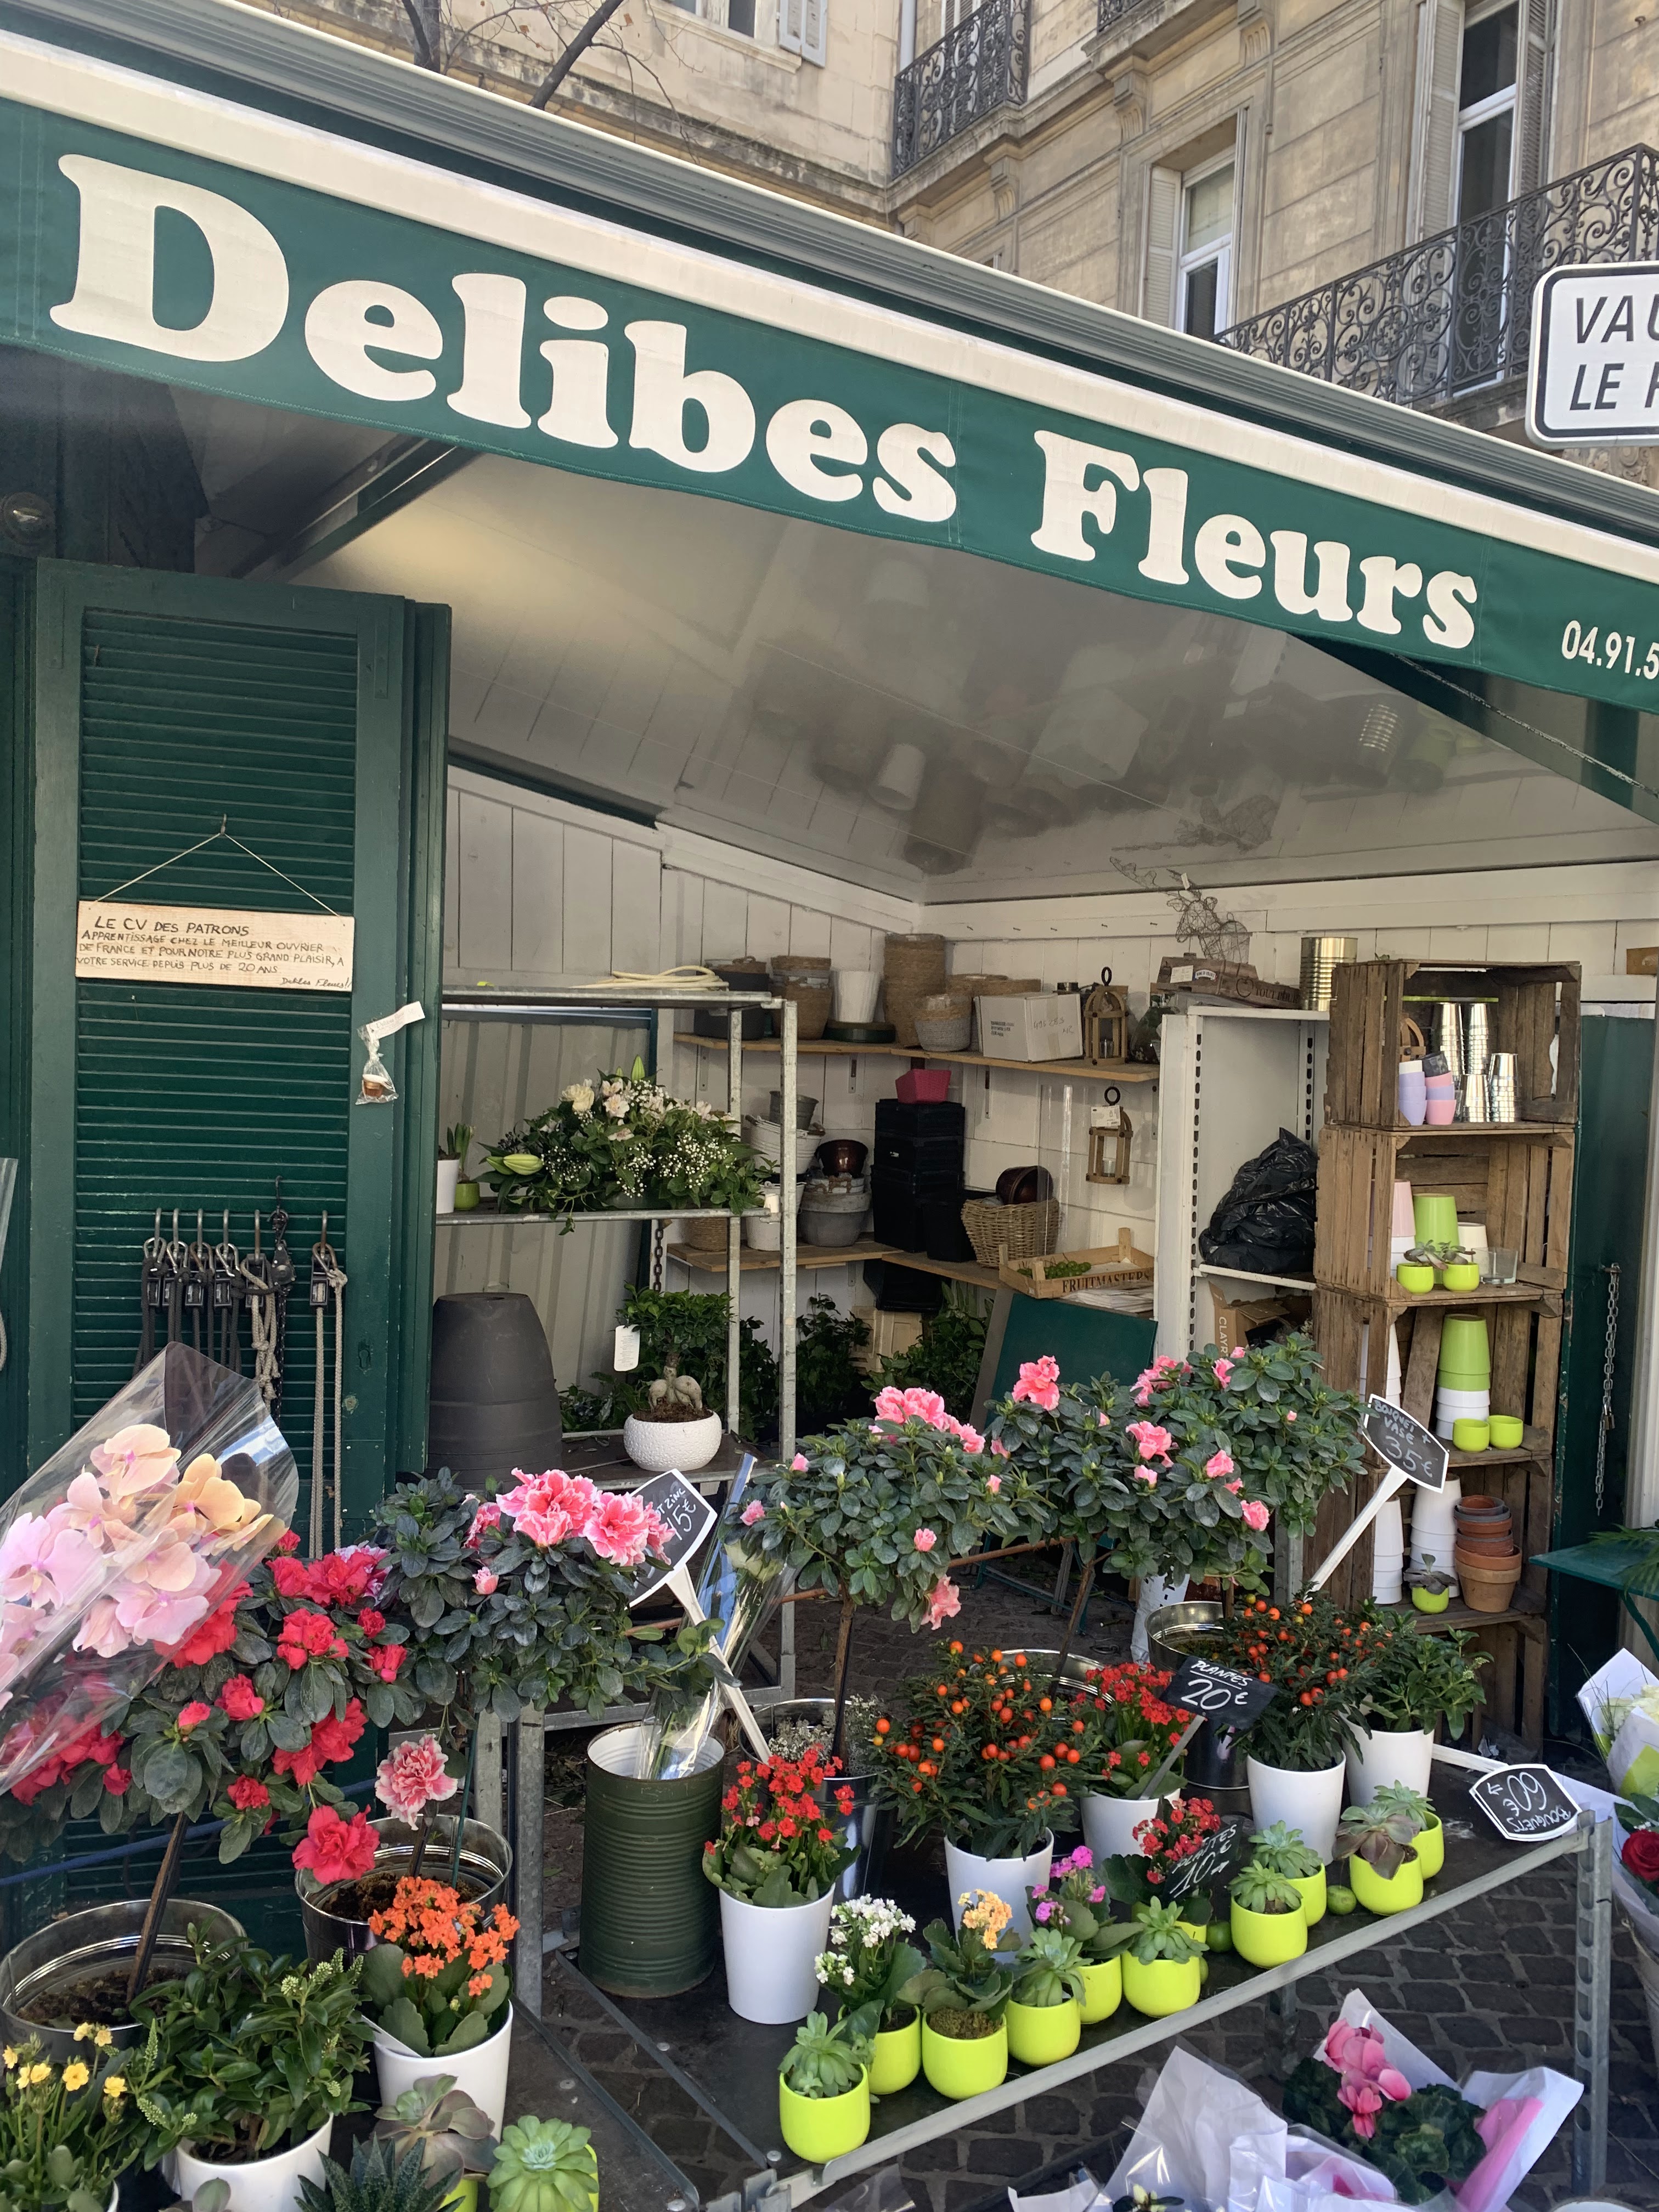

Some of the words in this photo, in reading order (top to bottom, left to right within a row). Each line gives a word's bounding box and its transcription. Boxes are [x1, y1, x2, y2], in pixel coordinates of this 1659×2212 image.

[1570, 362, 1624, 410] LE
[50, 154, 956, 523] Delibes
[1030, 430, 1477, 649] Fleurs
[94, 916, 116, 929] LE
[123, 918, 148, 930] CV
[154, 921, 179, 933] DES
[186, 922, 250, 936] PATRONS
[79, 943, 94, 952] DE
[97, 942, 136, 954] FRANCE
[142, 946, 155, 955] ET
[159, 946, 187, 957] POUR
[188, 949, 223, 958] NOTRE
[227, 950, 252, 960] PLUS
[256, 952, 290, 962] GRAND
[337, 957, 345, 967] A
[81, 930, 166, 944] APPRENTISSAGE
[170, 937, 198, 945] CHEZ
[222, 939, 273, 950] MEILLEUR
[276, 941, 324, 953] OUVRIER
[76, 957, 108, 966] VOTRE
[111, 957, 149, 967] SERVICE
[153, 960, 184, 969] DEPUIS
[190, 961, 215, 971] PLUS
[238, 962, 256, 972] 20
[1062, 1271, 1150, 1293] FRUITMASTERS
[1218, 1316, 1228, 1357] CLAYR
[1373, 1399, 1418, 1433] BOUQUET
[1384, 1416, 1415, 1446] VASE
[1385, 1435, 1434, 1478] 35€
[1191, 1660, 1253, 1686] PLANTES
